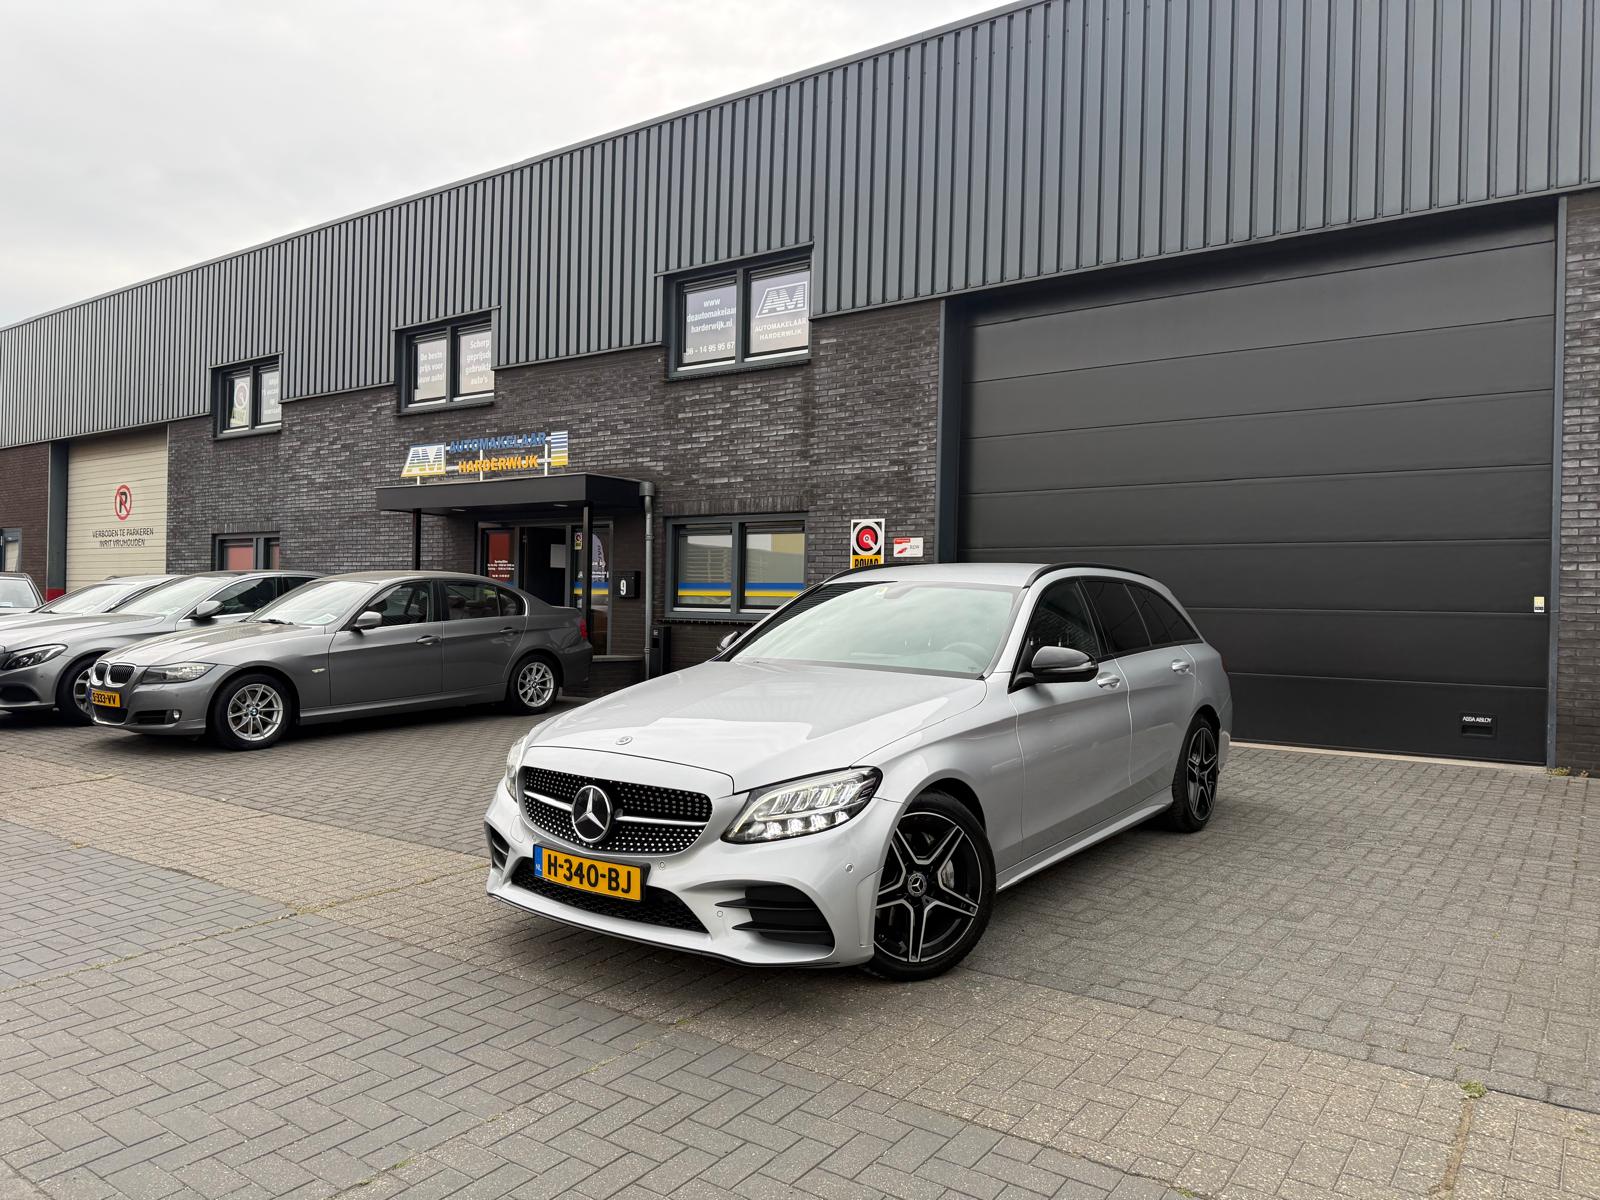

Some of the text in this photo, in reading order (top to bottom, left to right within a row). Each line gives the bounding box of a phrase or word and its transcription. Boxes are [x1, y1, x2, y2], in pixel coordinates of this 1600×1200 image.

[703, 298, 721, 307] www
[690, 318, 733, 333] harderwijk.nl
[754, 317, 806, 332] AUTOMAKELAAR
[759, 328, 802, 341] HARDERWIJK
[726, 341, 735, 350] 67
[449, 432, 547, 454] AUTOMAKELAAR
[458, 454, 539, 474] HARDERWIJK
[92, 529, 118, 538] VERBODEN
[126, 527, 154, 537] PARKEREN
[620, 579, 627, 596] 9
[548, 854, 631, 893] H-340-BJ
